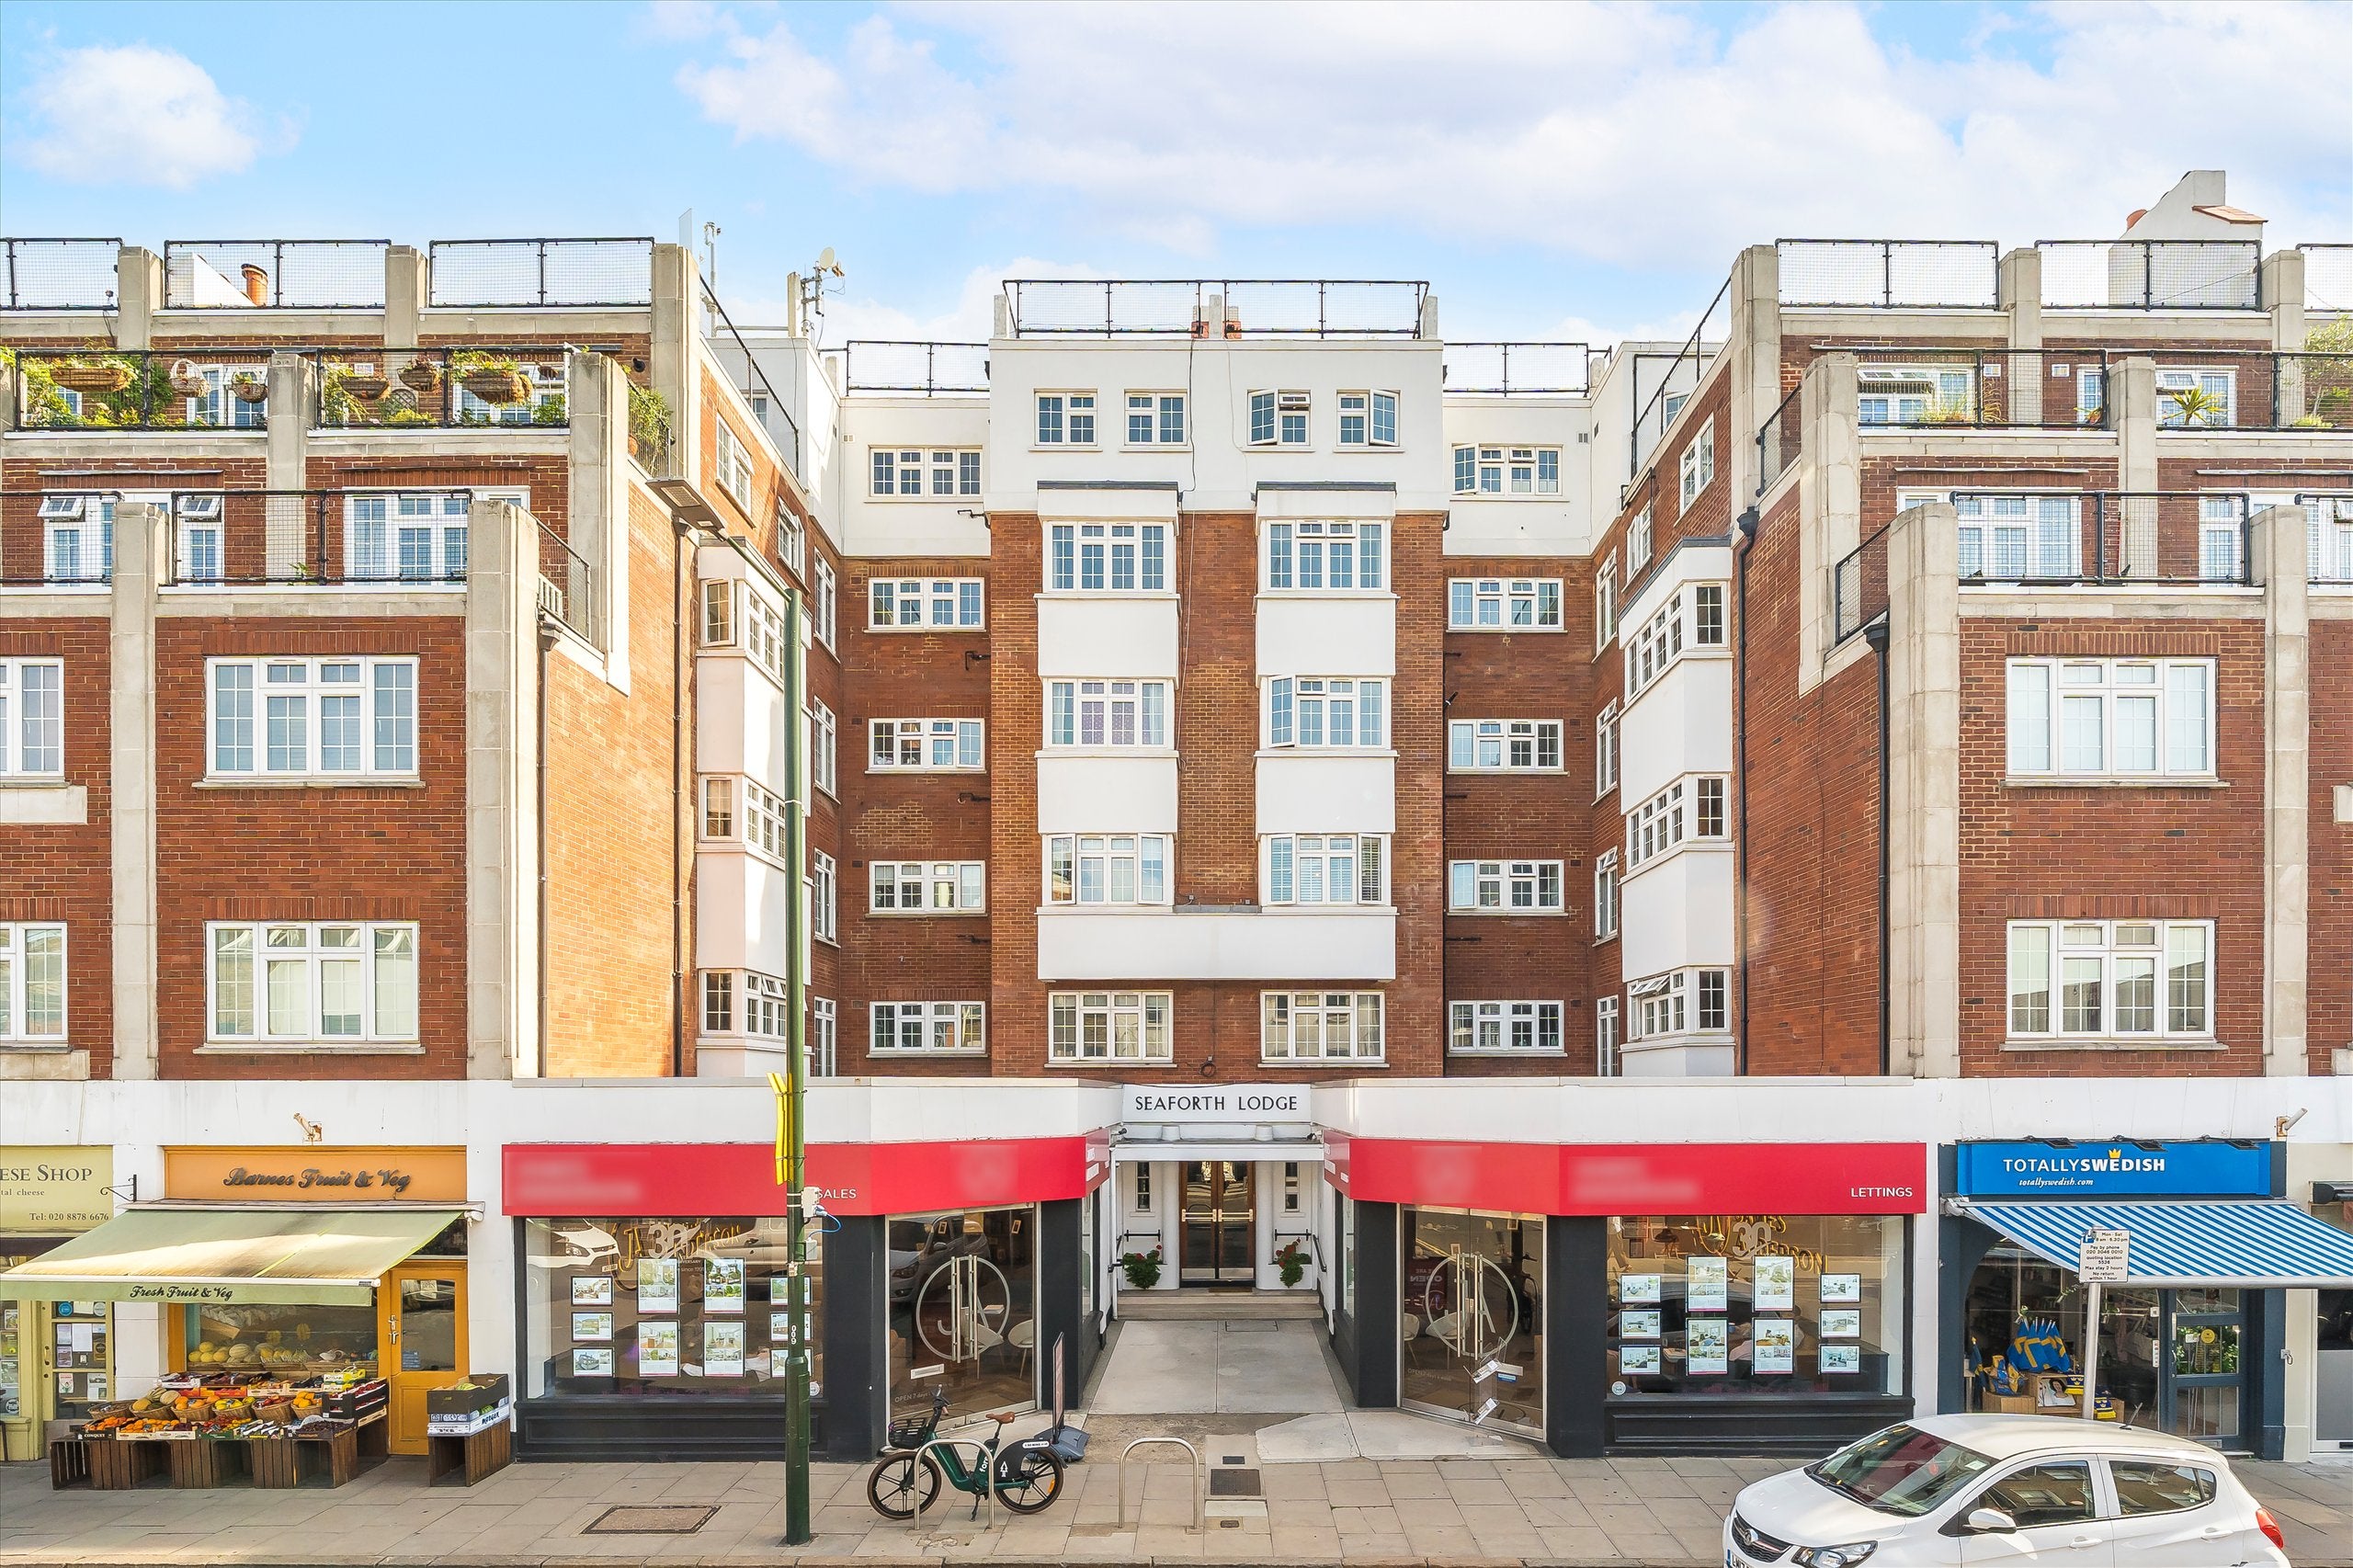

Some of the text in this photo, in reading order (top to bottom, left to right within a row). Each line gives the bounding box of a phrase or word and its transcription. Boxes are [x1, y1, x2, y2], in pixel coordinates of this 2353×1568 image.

[1135, 1096, 1297, 1110] SEAFORTH LODGE
[2003, 1158, 2165, 1172] TOTALLYSWEDISH
[37, 1164, 92, 1181] SHOP
[223, 1167, 411, 1192] Barnes Fruit & Veg
[2018, 1177, 2094, 1187] totallyswedish.com
[817, 1188, 857, 1199] SALES
[1850, 1187, 1913, 1198] LETTINGS
[29, 1212, 109, 1221] Tel: 020 8878 6676
[130, 1285, 233, 1301] Fresh Fruit & Veg
